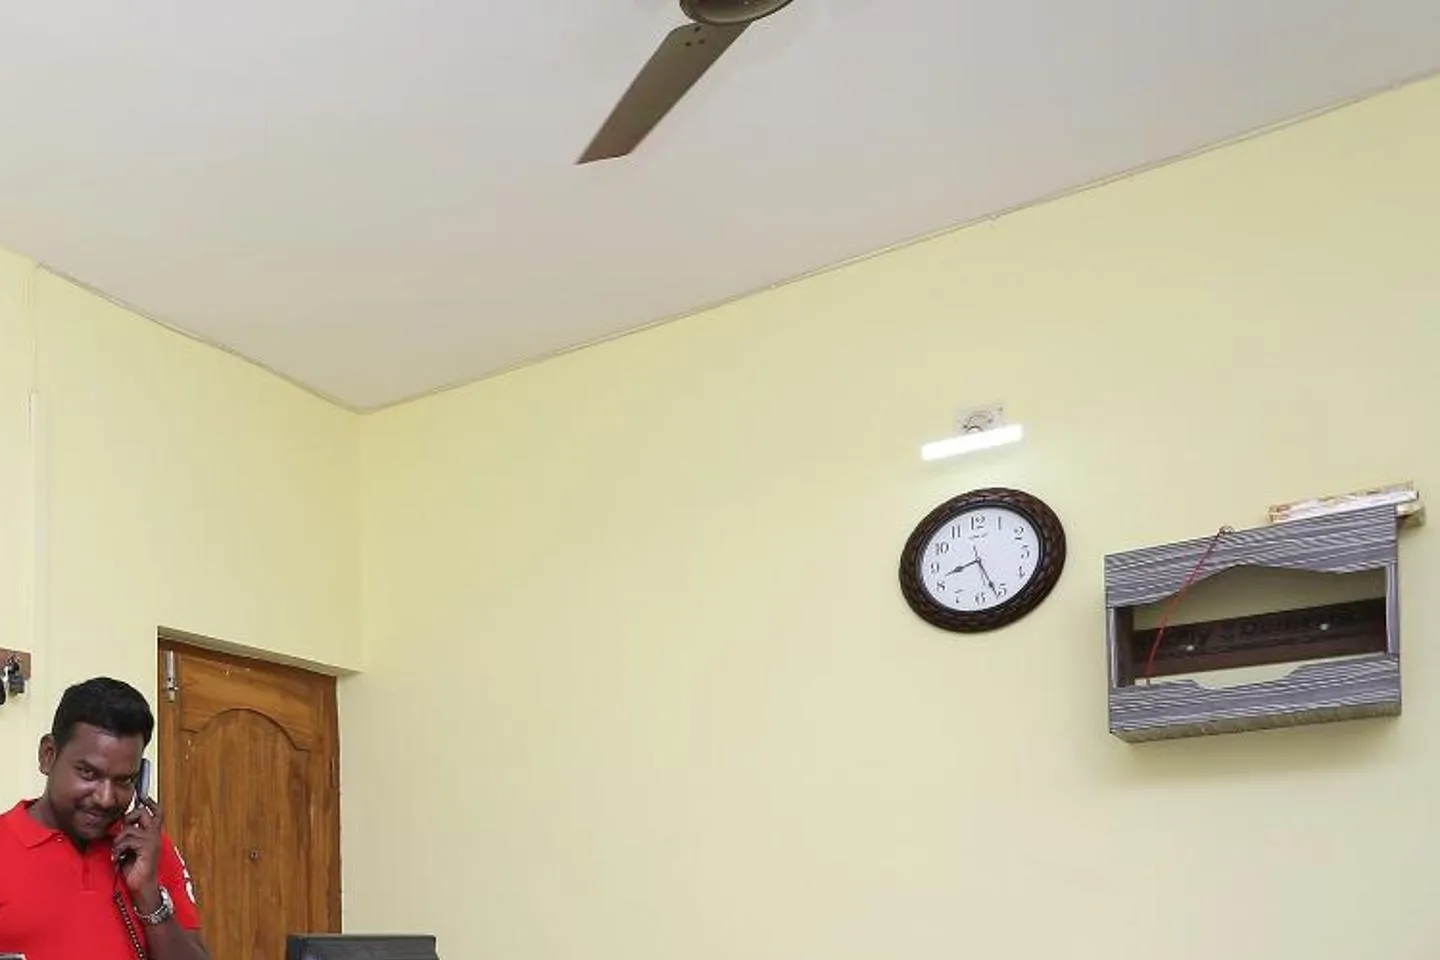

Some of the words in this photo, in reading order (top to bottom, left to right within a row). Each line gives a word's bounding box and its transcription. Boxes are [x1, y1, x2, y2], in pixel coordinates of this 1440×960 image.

[970, 516, 985, 530] 12
[951, 525, 961, 539] 11
[1014, 526, 1025, 540] 2
[935, 541, 949, 555] 10
[1020, 545, 1030, 559] 3
[931, 562, 940, 574] 9
[936, 581, 946, 593] 8
[998, 584, 1007, 597] 5
[975, 592, 986, 605] 6
